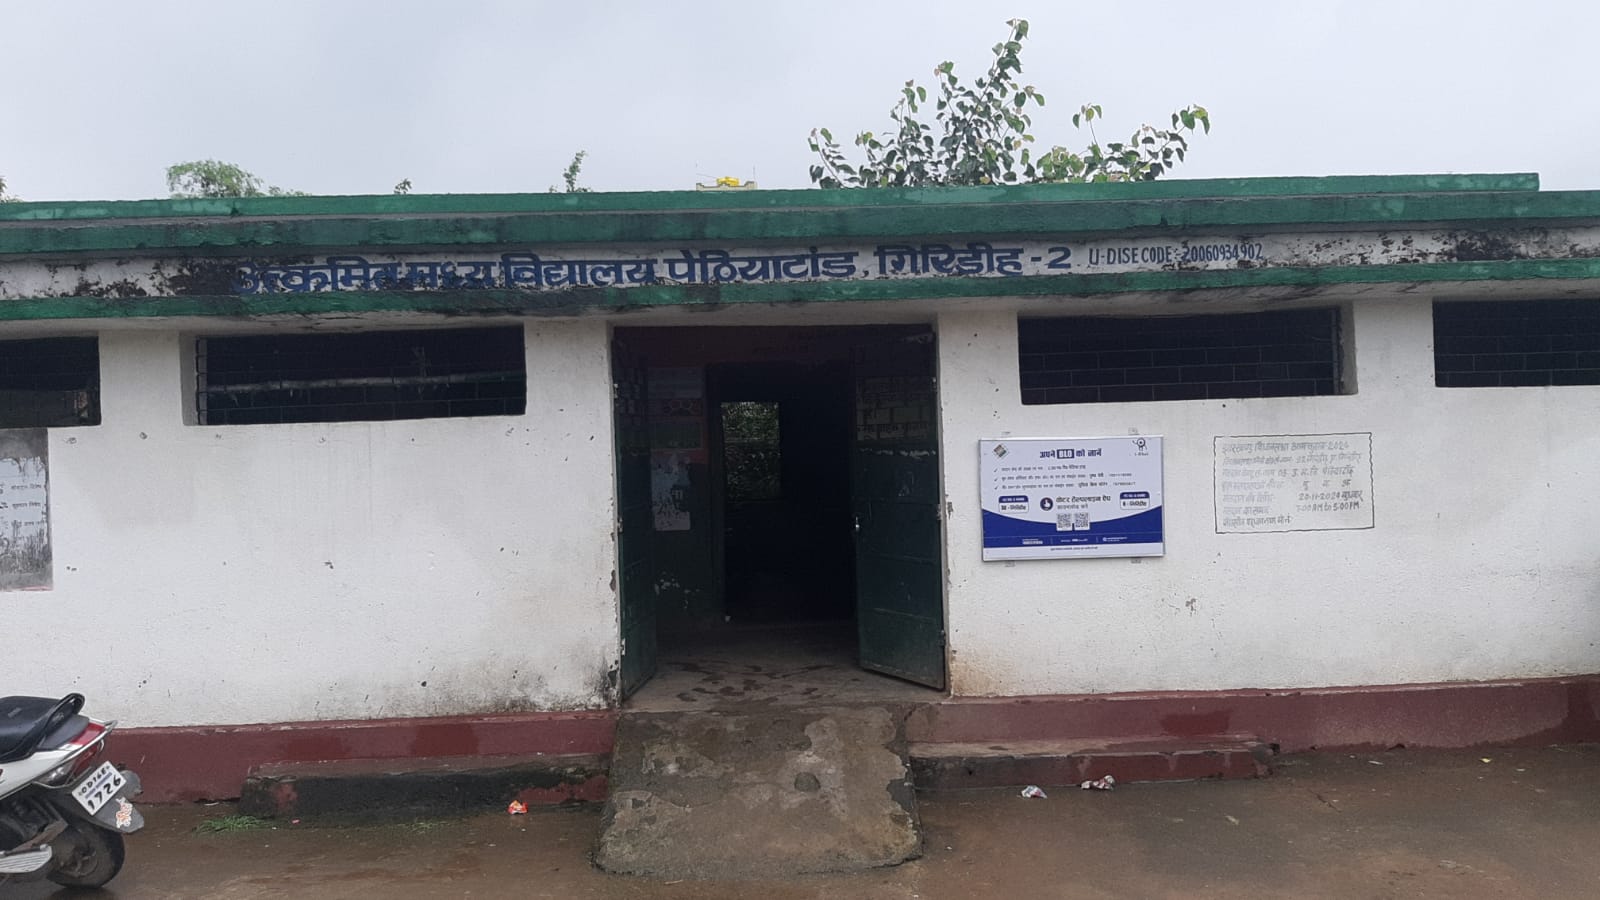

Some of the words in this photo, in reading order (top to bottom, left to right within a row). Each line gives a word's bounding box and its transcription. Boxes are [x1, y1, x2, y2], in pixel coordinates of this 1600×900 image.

[501, 253, 656, 288] विद्यालय
[876, 244, 1025, 275] गिरिडीह
[1089, 248, 1138, 265] U-DISE
[1040, 450, 1056, 459] अपने
[1058, 450, 1074, 458] BLO
[1076, 450, 1085, 458] को
[1087, 447, 1102, 457] जानें
[87, 774, 121, 811] 1726
